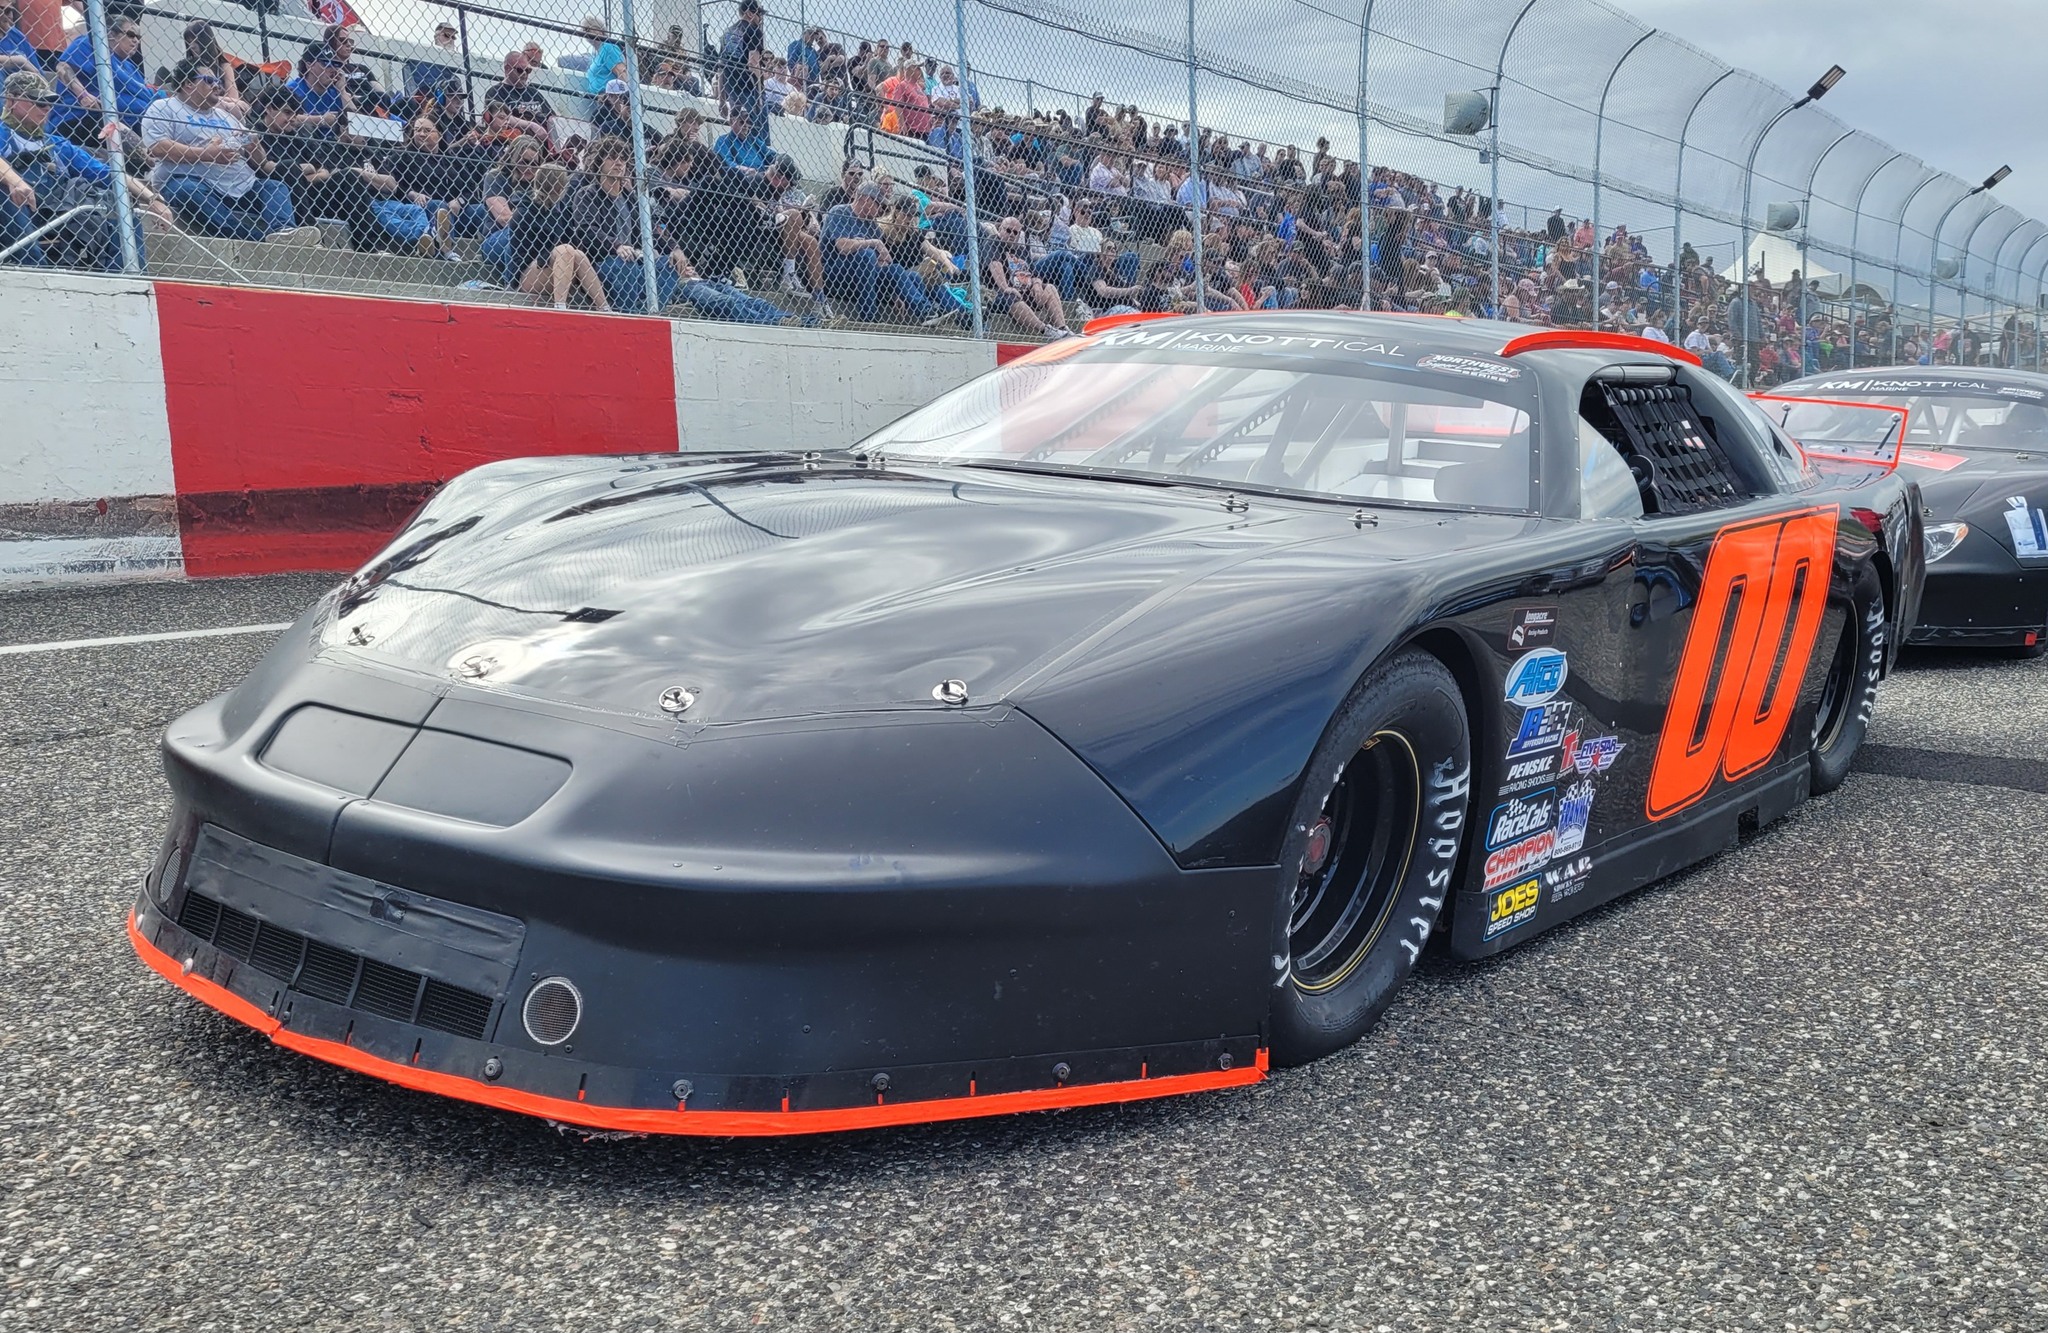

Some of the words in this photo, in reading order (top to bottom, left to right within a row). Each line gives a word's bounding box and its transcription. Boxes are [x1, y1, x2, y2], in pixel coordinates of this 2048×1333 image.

[1172, 342, 1243, 352] MARINE
[1186, 331, 1405, 357] KNOTTICAL
[1433, 354, 1519, 373] NORTHWEST
[1817, 381, 1864, 390] KM
[1874, 380, 1990, 390] KNOTTICAL
[1646, 502, 1841, 821] 00
[1506, 654, 1565, 699] AFCO
[1581, 741, 1600, 758] FIVE
[1600, 738, 1617, 753] STAR
[1506, 755, 1555, 781] PENSKE
[1508, 780, 1527, 793] RACING
[1528, 776, 1546, 788] SHOCKS
[1490, 799, 1552, 845] RaceCals
[1486, 830, 1555, 875] CHAMPION
[1491, 879, 1539, 922] JOES
[1487, 915, 1512, 935] SPEED
[1513, 905, 1536, 922] SHOP
